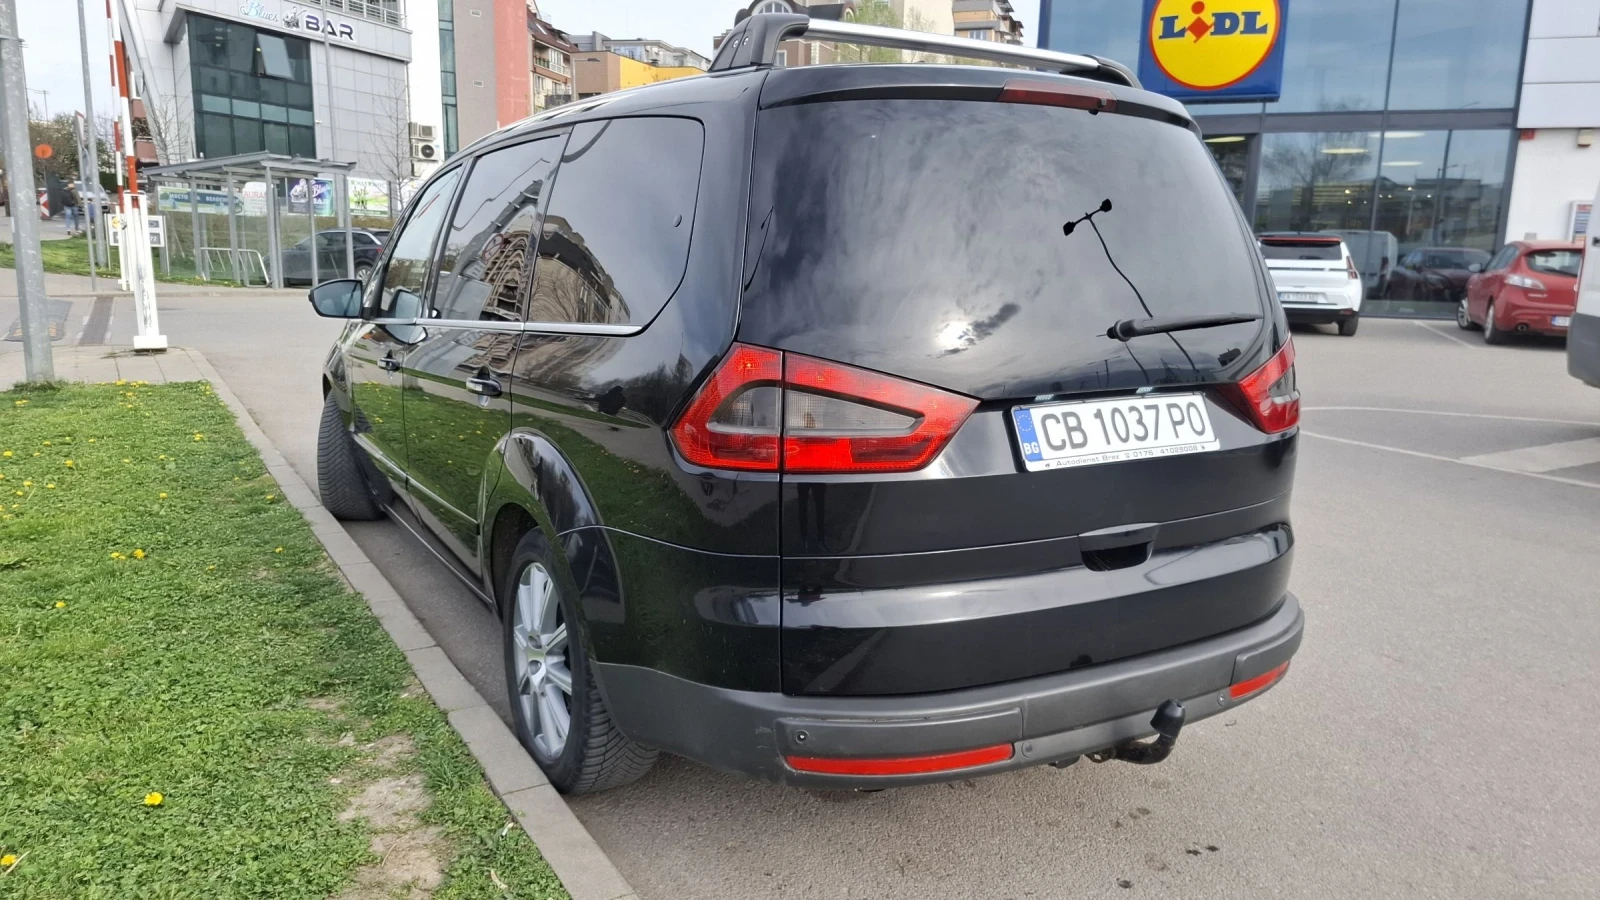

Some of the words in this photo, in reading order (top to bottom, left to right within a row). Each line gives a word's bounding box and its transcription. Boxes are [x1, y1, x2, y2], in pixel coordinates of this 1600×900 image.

[240, 0, 278, 22] Blues
[306, 15, 354, 40] BAR
[1041, 411, 1088, 451] CB
[1093, 404, 1159, 445] 1037
[1166, 402, 1206, 438] PO
[1023, 442, 1040, 455] BG
[1056, 456, 1100, 467] Autodienst
[1133, 449, 1154, 458] 0176
